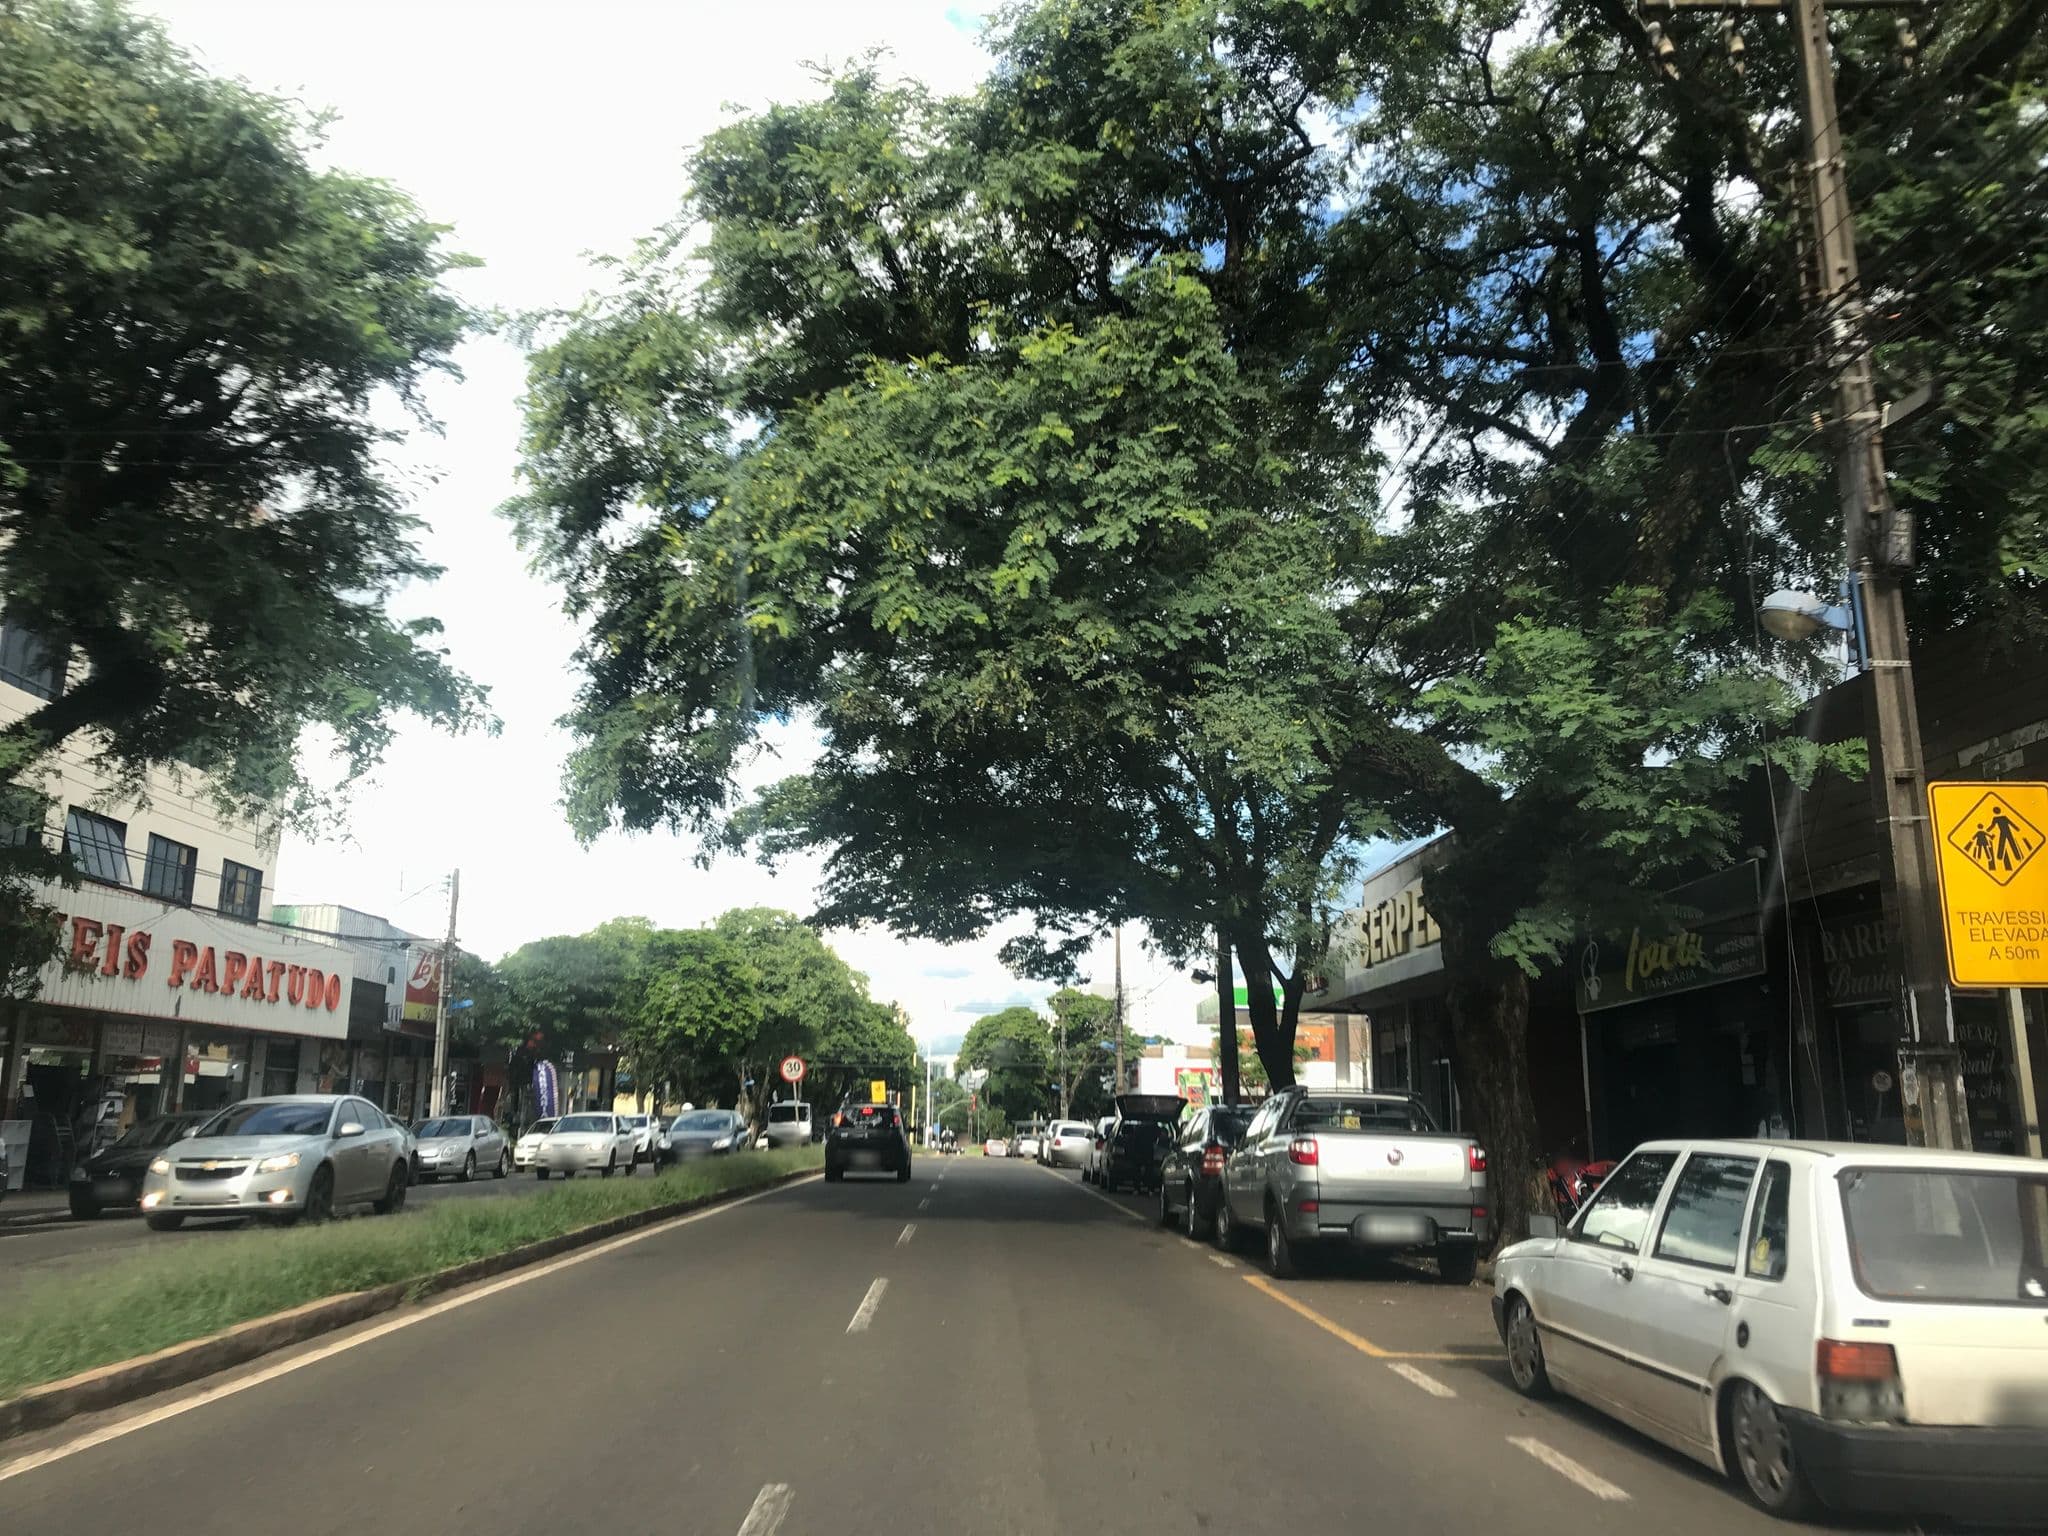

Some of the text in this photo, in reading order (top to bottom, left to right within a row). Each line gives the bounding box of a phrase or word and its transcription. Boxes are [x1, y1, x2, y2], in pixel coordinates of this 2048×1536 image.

[1957, 911, 2048, 926] TRAVESSI
[1989, 945, 2040, 961] A 50m
[168, 939, 341, 1012] PAPATUDO
[785, 1061, 801, 1073] 30
